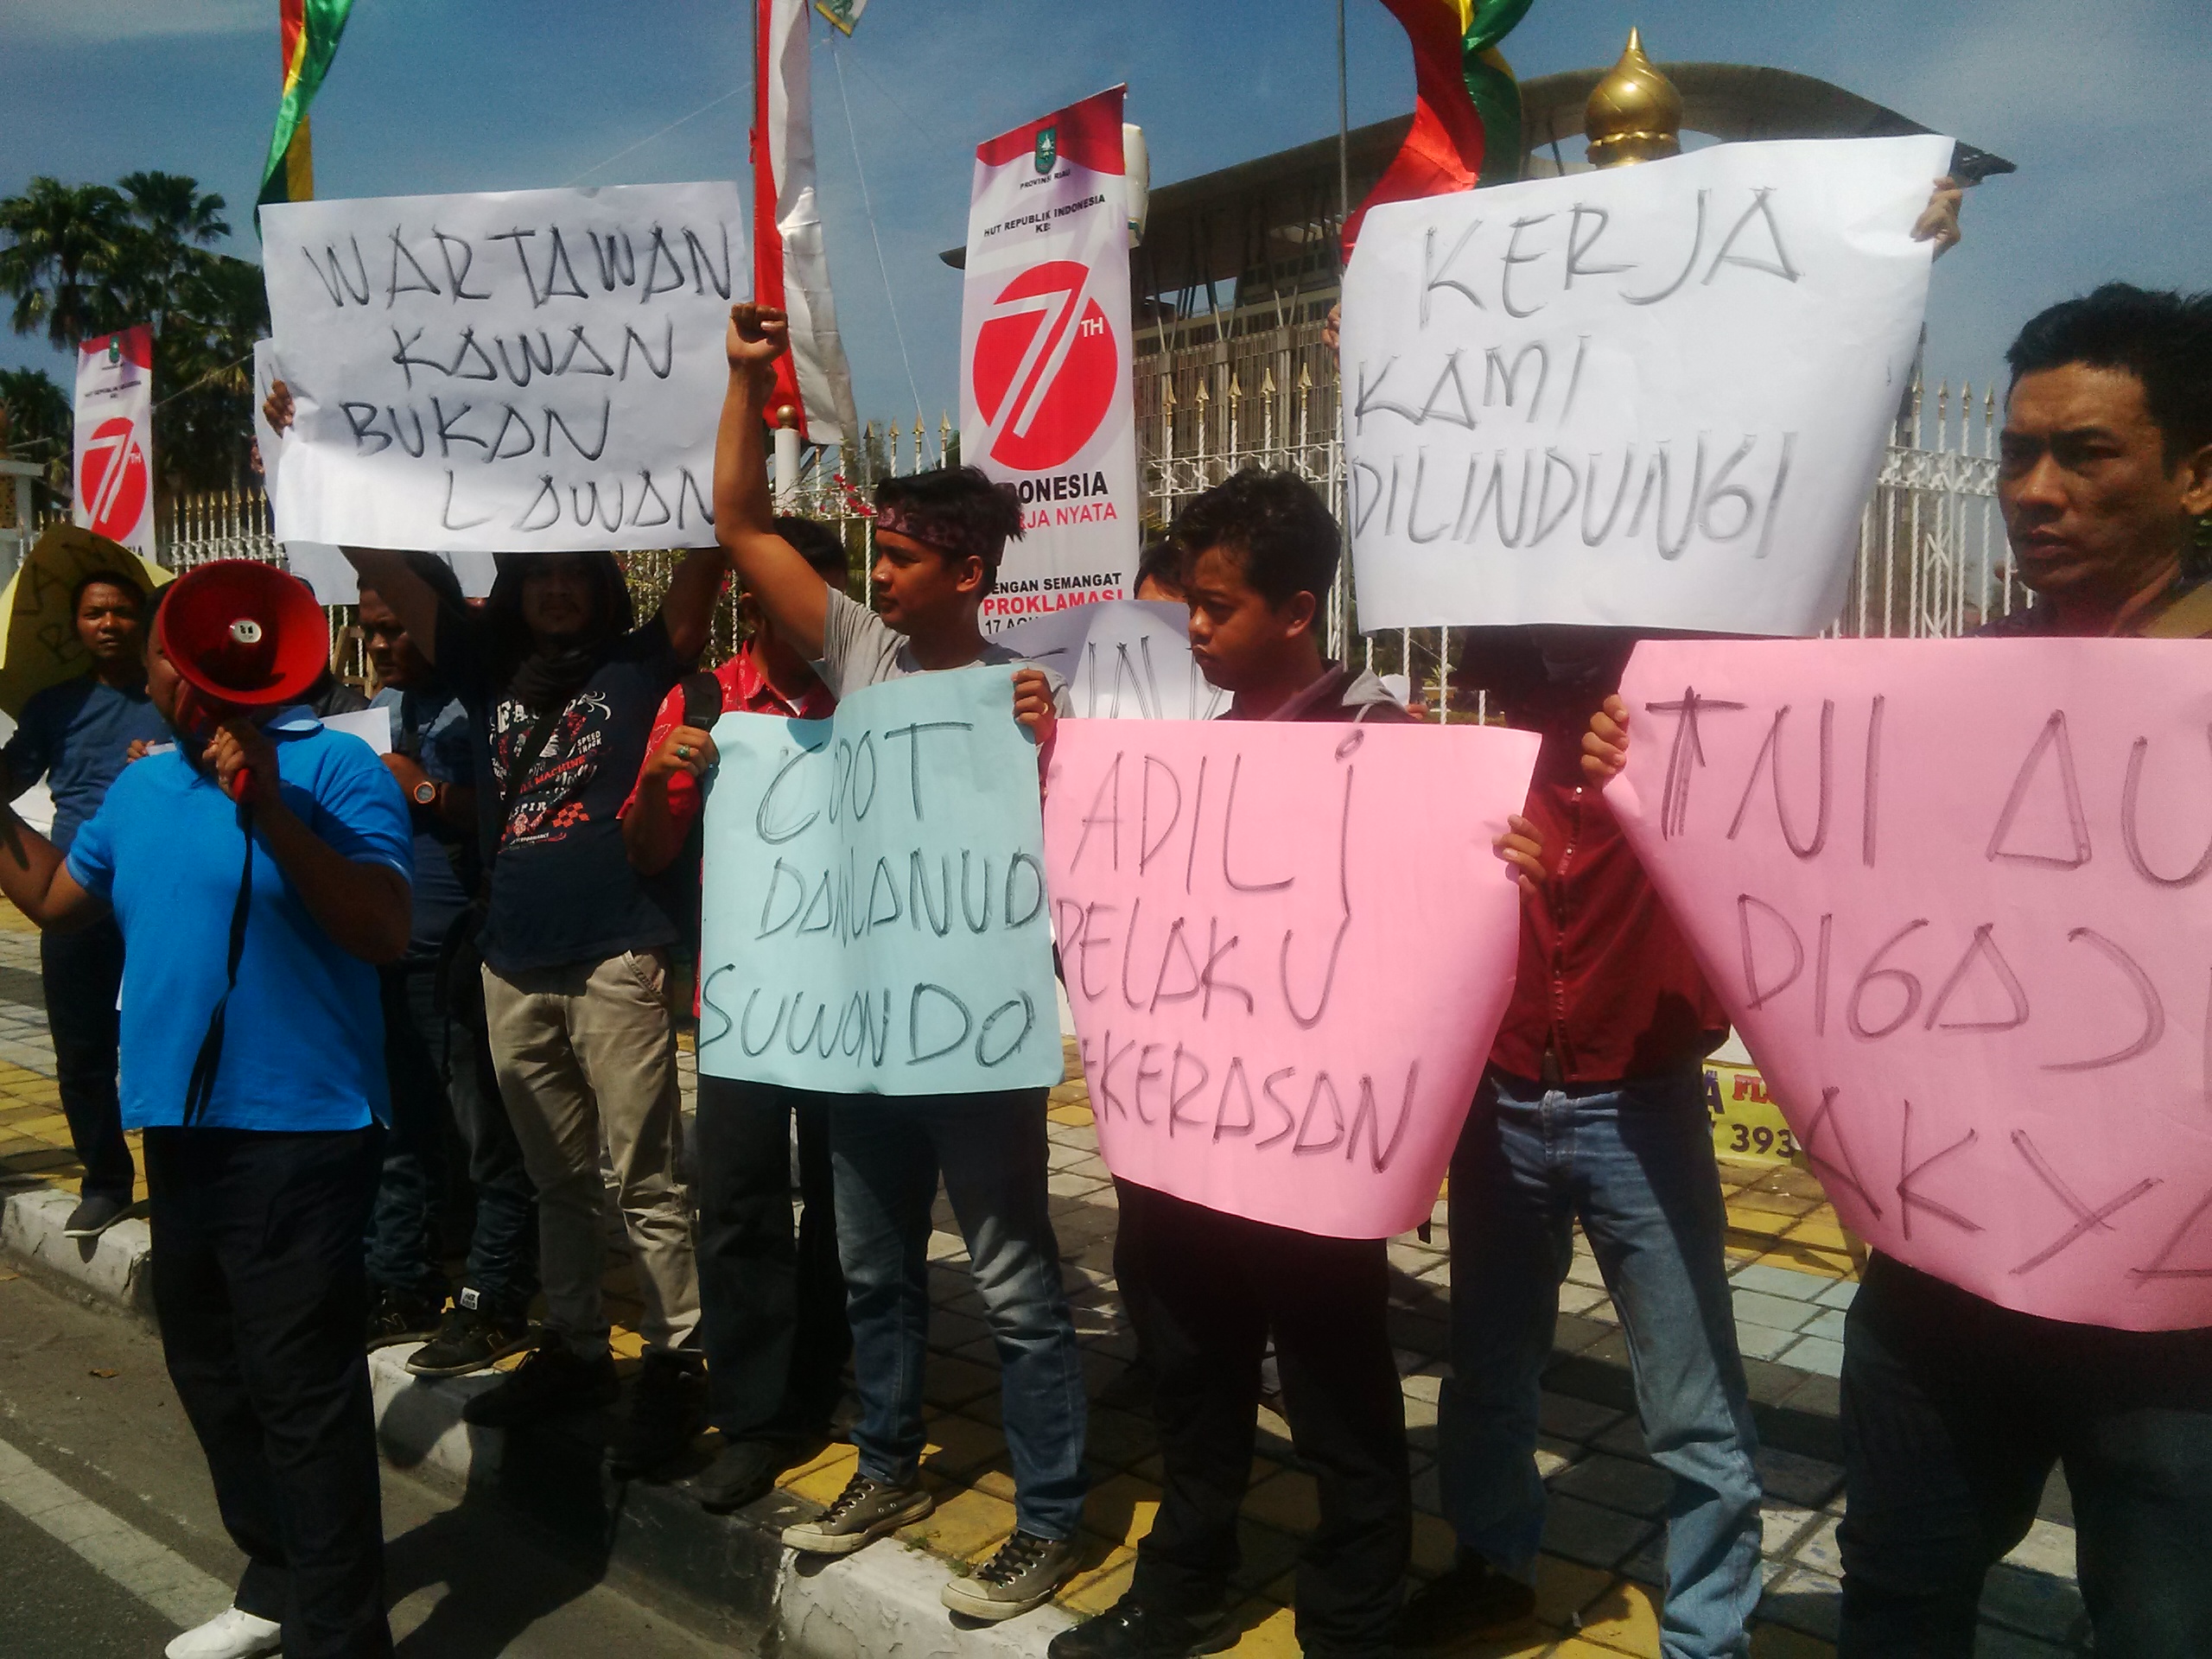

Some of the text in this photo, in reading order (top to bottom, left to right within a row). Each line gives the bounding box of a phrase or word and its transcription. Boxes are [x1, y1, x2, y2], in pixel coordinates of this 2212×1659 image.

[1054, 168, 1071, 180] RIAU
[984, 194, 1105, 237] HUT REPUBLIK INDONESIA
[302, 221, 732, 309] WARTAWAN
[1421, 187, 1804, 329] KERJA
[392, 315, 673, 390] KAWAN
[1354, 334, 1592, 435] KAMI
[340, 396, 611, 463] BUKAN
[1018, 471, 1109, 504] ONESIA
[1019, 502, 1117, 531] RJA NYATA
[1351, 430, 1799, 560] DILINDUNGI
[983, 588, 1123, 616] PROKLAMASI
[993, 572, 1122, 594] ENGAN SEMANGAT
[985, 619, 1001, 634] 17
[1645, 685, 2212, 889] TNI AU
[1056, 896, 1351, 1030] PELAKU
